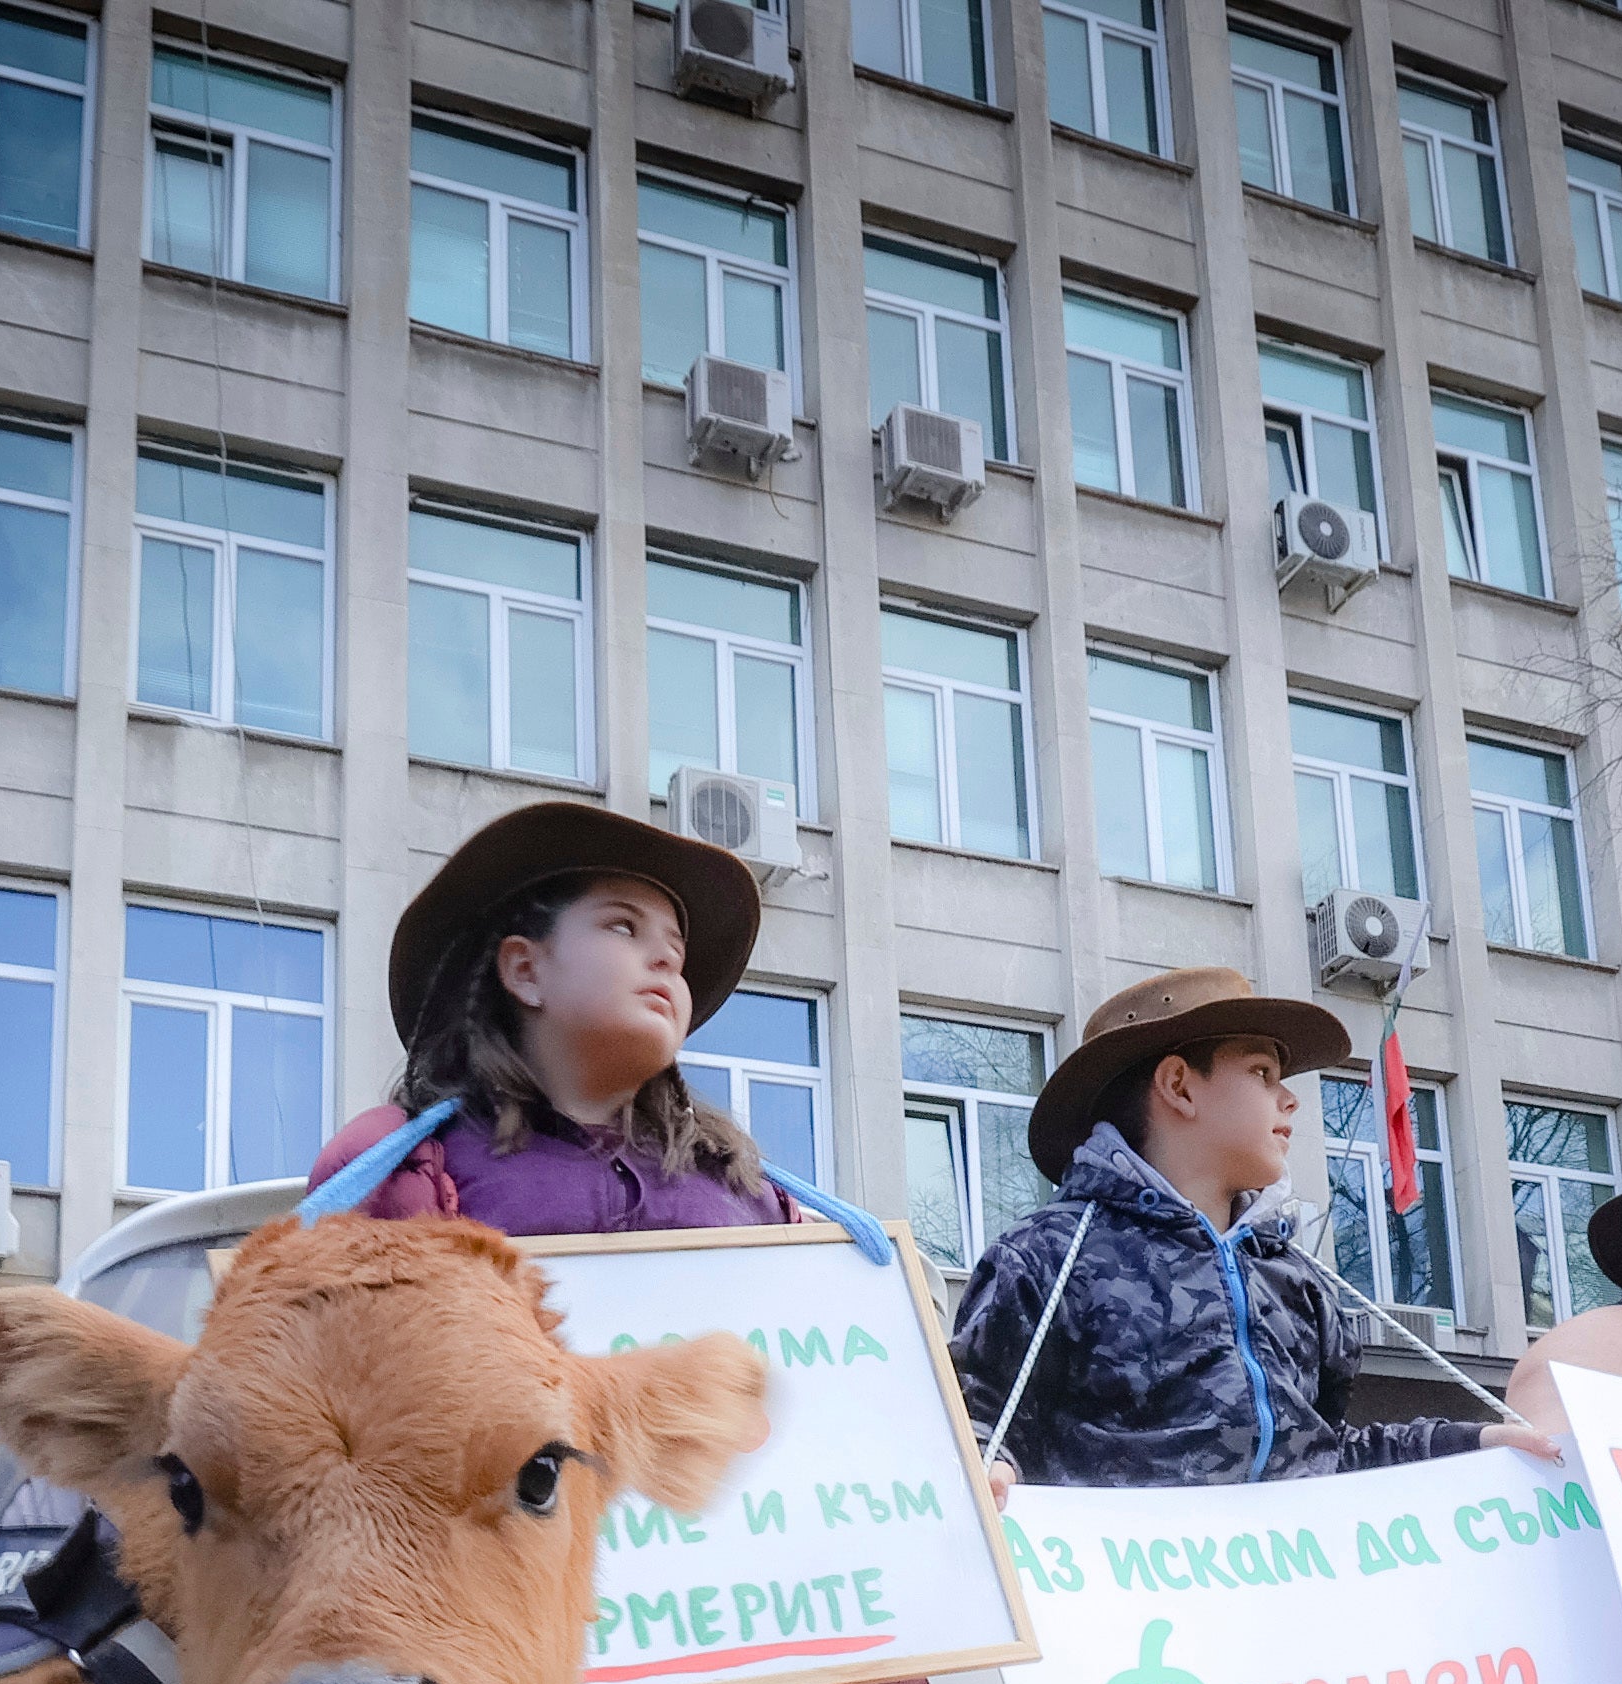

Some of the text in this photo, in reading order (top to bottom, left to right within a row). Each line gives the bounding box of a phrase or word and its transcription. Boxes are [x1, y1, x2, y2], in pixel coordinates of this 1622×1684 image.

[742, 1490, 786, 1536] И
[815, 1480, 944, 1529] КЪМ
[1001, 1481, 1602, 1593] Аз искам да съм
